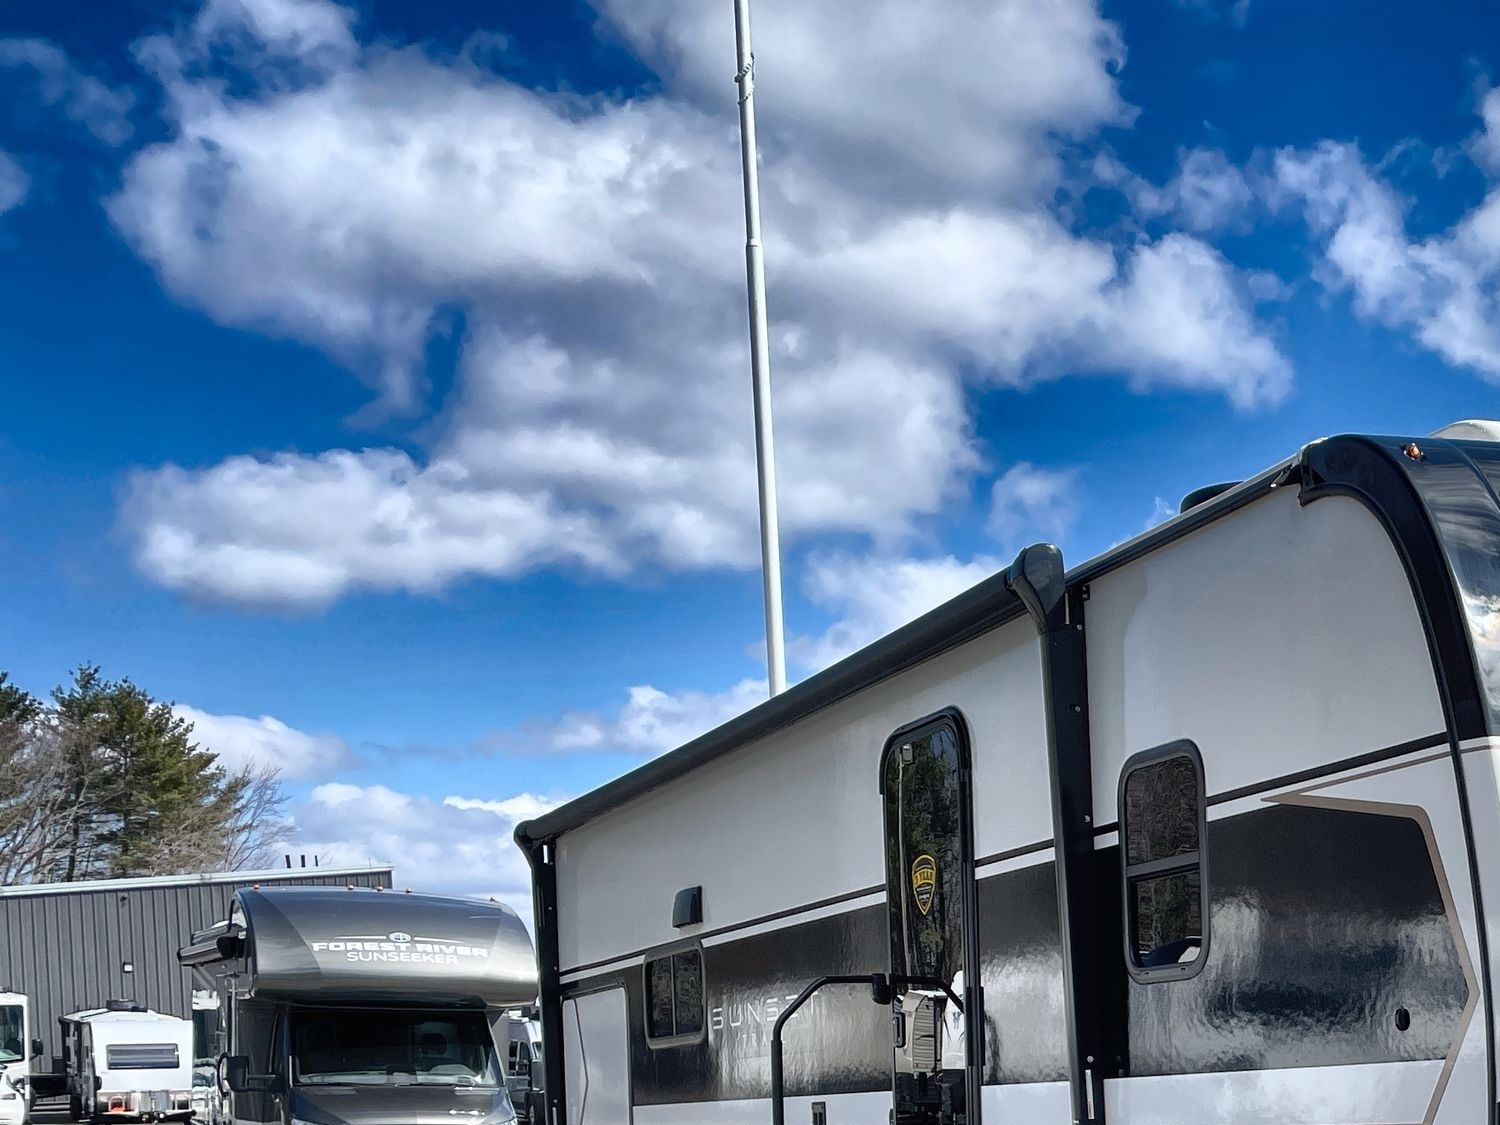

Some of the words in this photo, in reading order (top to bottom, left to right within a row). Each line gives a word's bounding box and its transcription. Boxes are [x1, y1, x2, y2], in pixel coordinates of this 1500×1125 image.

[311, 942, 412, 952] FOREST
[415, 942, 489, 957] RIVER
[346, 951, 459, 964] SUNSEEKER
